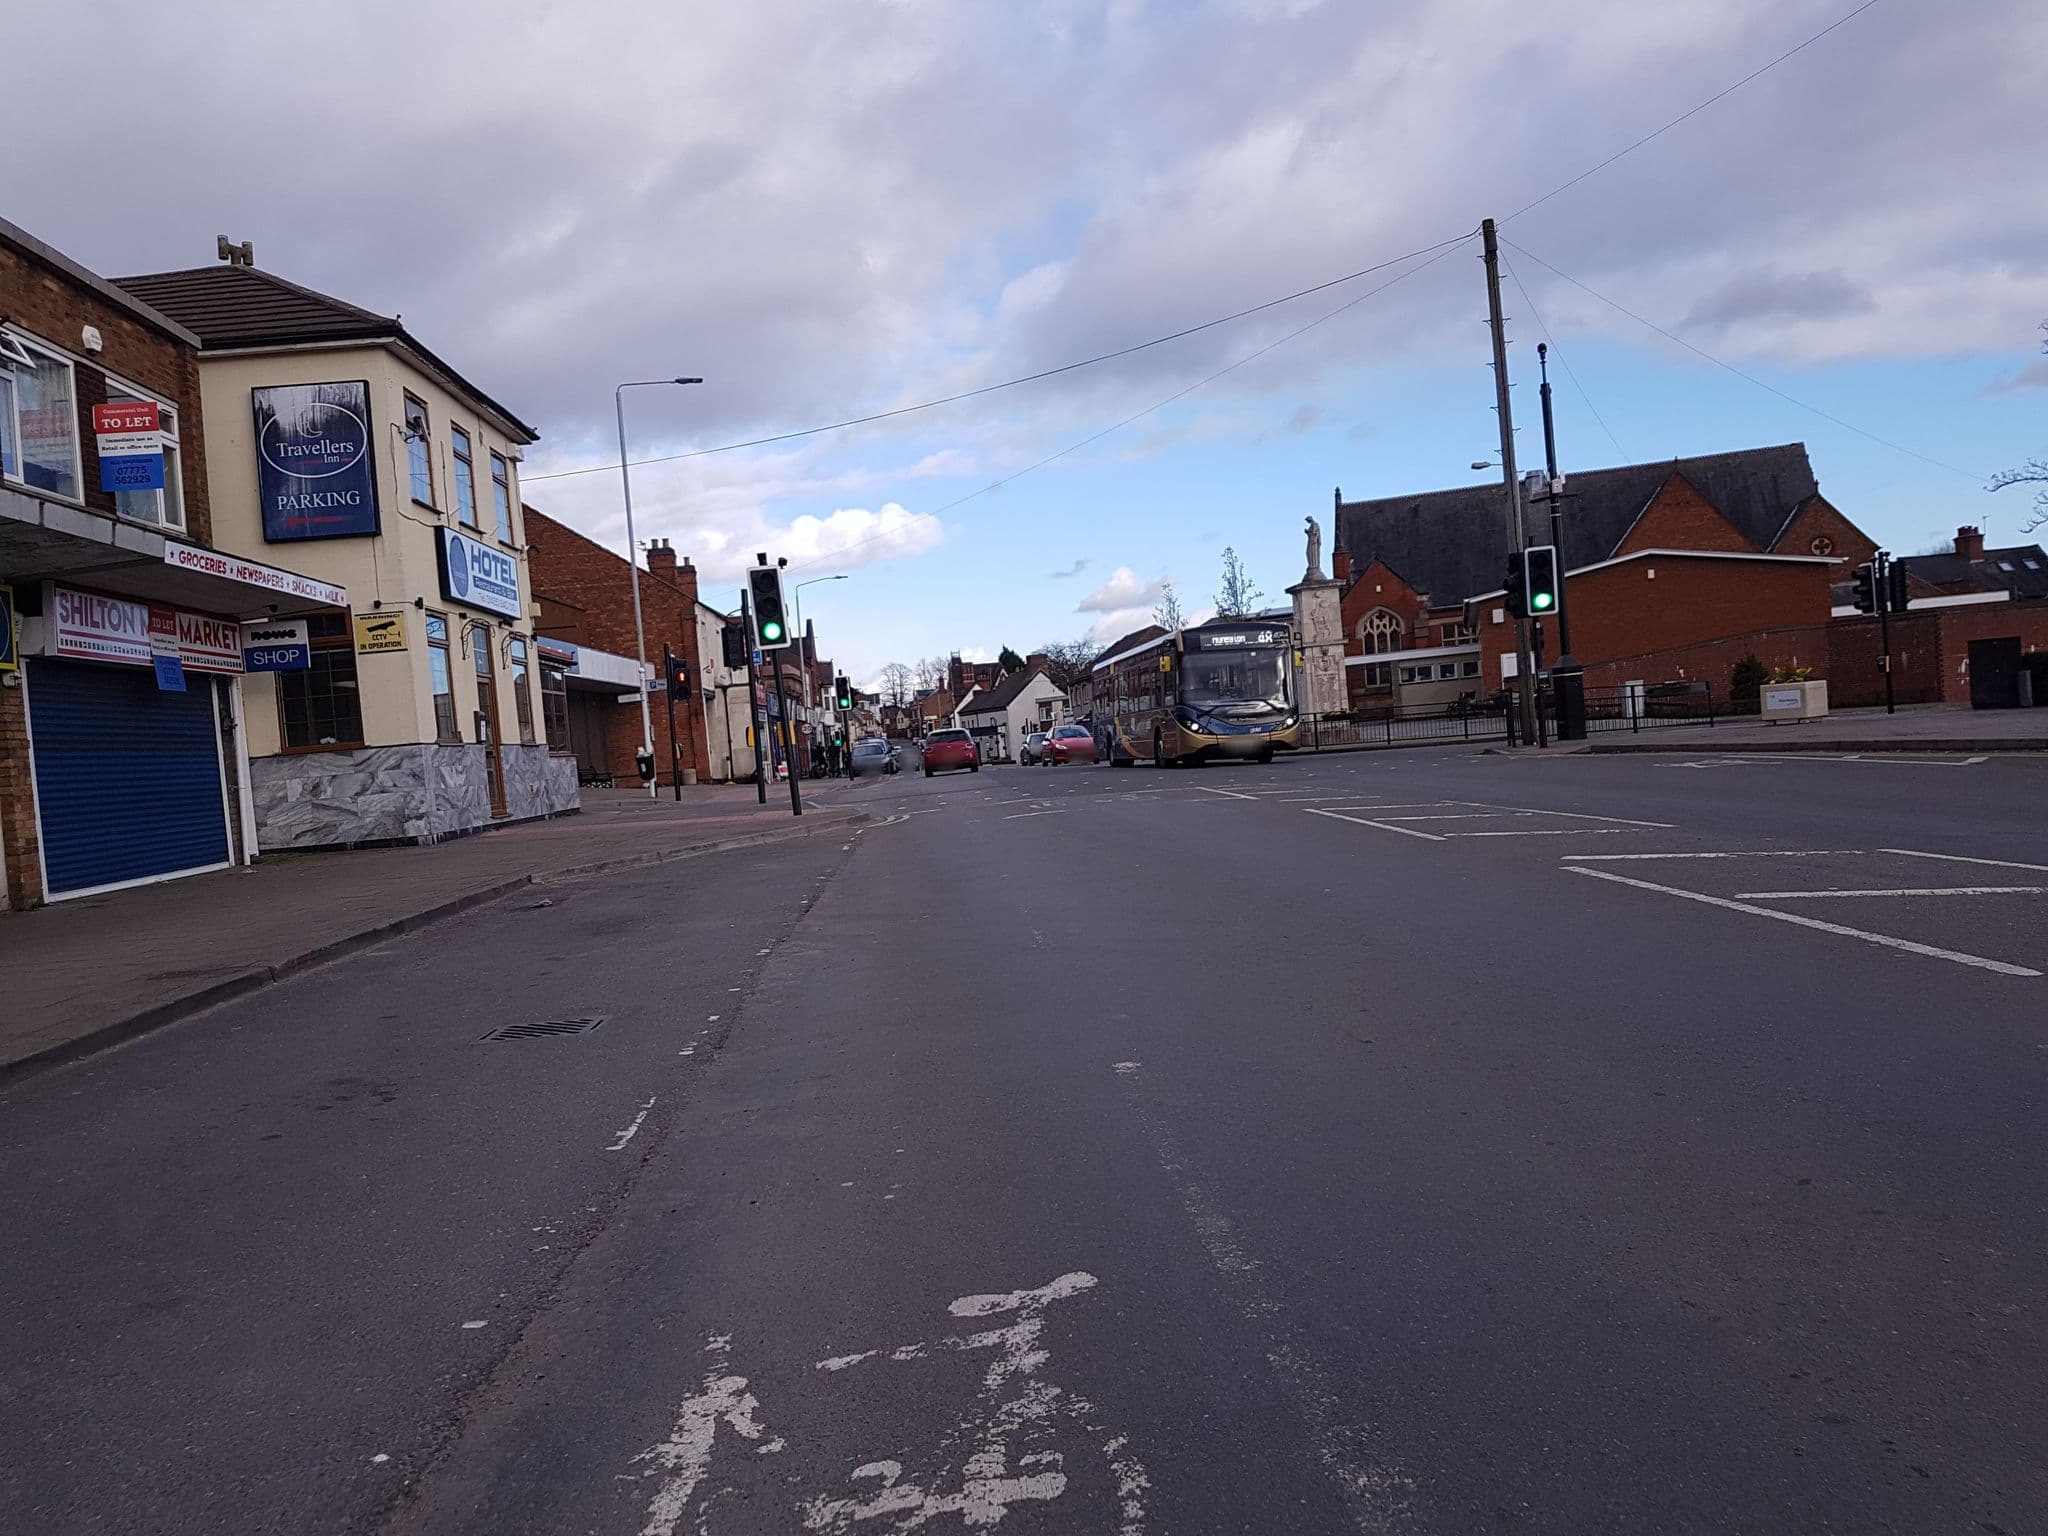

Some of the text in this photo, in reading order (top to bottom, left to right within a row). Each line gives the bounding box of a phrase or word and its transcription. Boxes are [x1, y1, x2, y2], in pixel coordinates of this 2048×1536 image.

[101, 416, 152, 429] TO LET
[276, 439, 354, 457] Travellers
[324, 454, 340, 464] Inn
[117, 465, 147, 476] 07775
[115, 474, 151, 485] 562929
[277, 490, 361, 511] PARKING
[471, 544, 516, 587] HOTEL
[178, 550, 227, 574] GROCERIES
[236, 565, 284, 588] NEWSPAPERS
[292, 580, 317, 598] SNACKS
[59, 591, 136, 635] SHILTON
[177, 615, 238, 651] MARKET
[151, 617, 174, 631] TO LET
[372, 633, 388, 641] CCTV
[368, 640, 402, 650] OPERATION
[253, 649, 300, 665] SHOP
